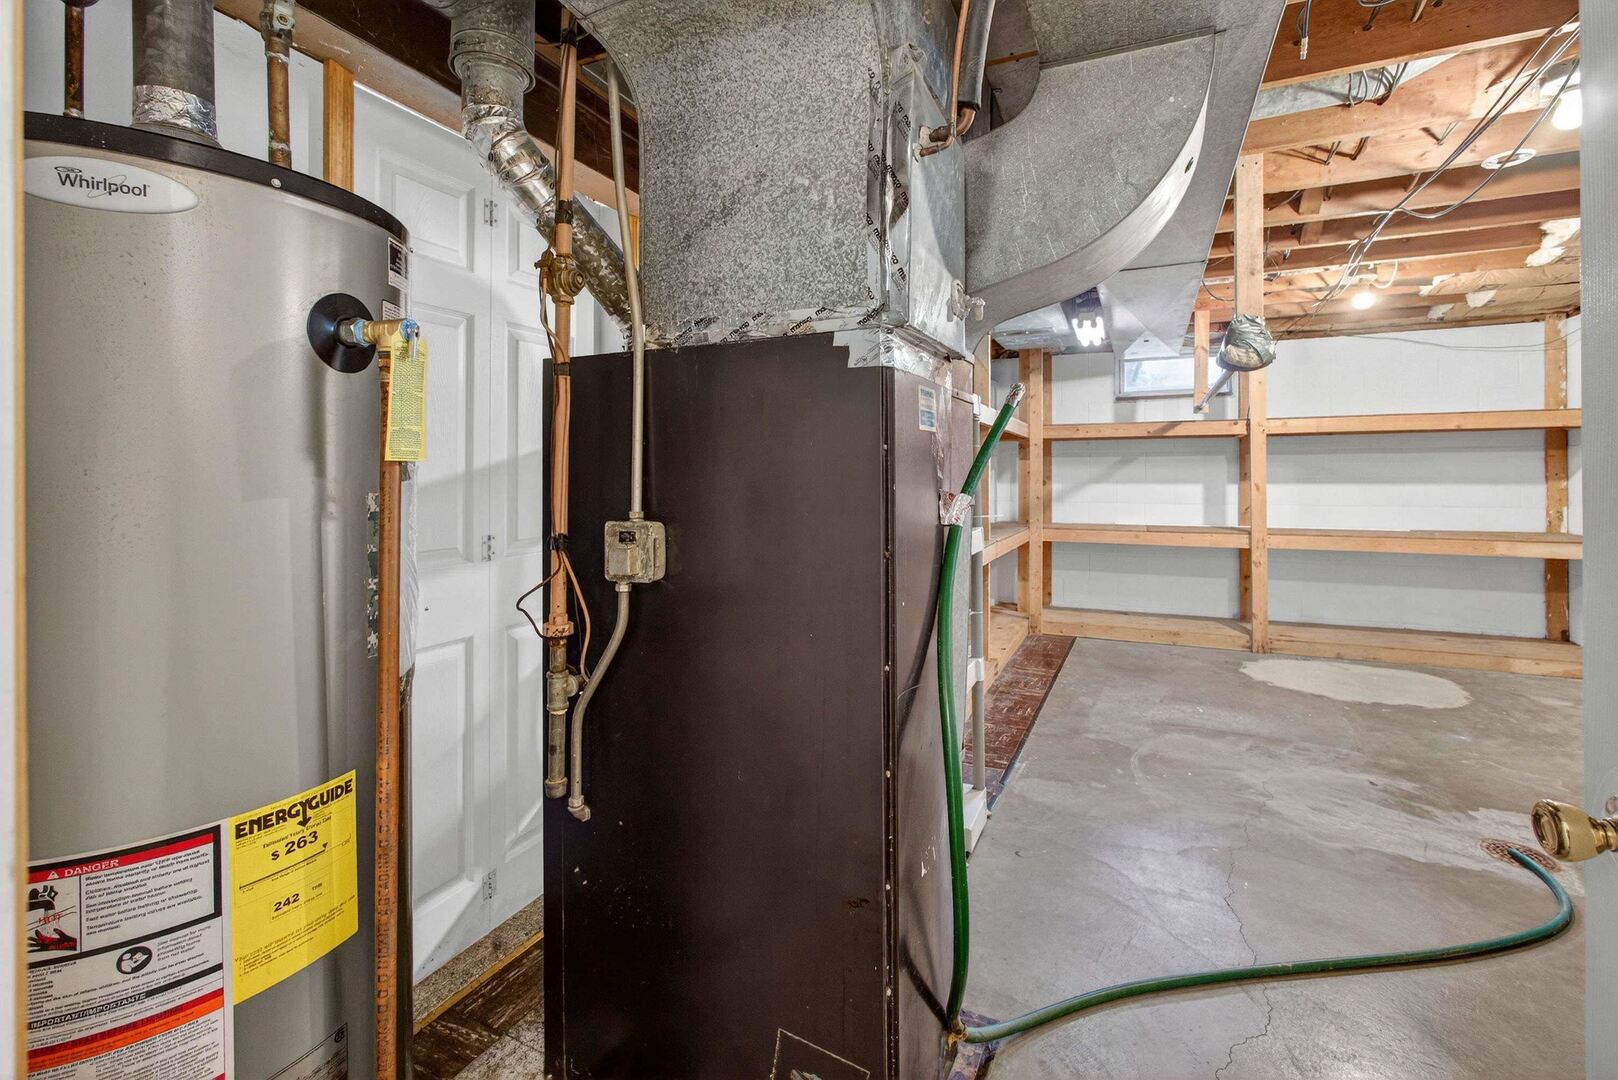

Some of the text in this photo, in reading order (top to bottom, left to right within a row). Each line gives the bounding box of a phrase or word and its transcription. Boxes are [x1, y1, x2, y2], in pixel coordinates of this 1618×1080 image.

[57, 171, 147, 197] Whirlpool
[235, 778, 353, 840] ENERGYGUIDE
[284, 830, 319, 856] 263
[64, 858, 120, 877] DANGER
[273, 893, 300, 913] 242
